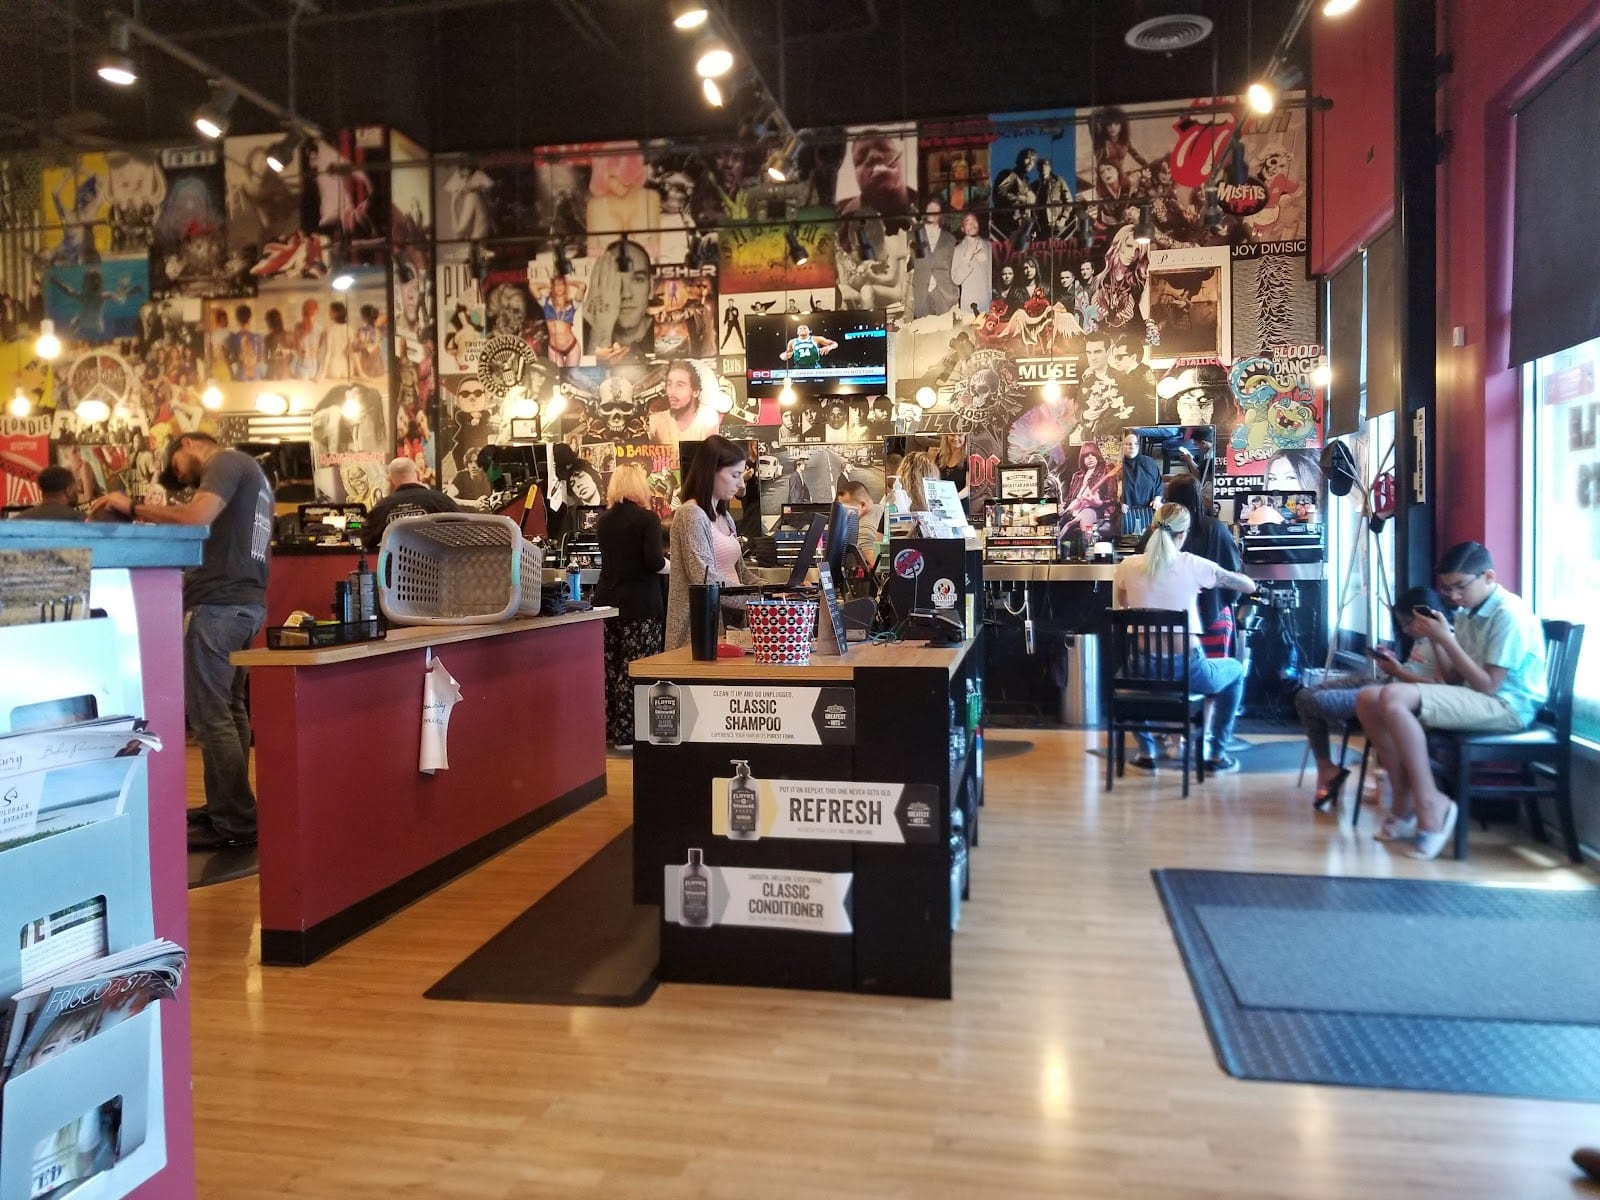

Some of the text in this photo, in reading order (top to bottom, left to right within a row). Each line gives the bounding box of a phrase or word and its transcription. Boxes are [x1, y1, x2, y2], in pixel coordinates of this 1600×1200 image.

[1218, 182, 1266, 201] MISFITS
[1232, 244, 1257, 256] JOY
[1273, 345, 1320, 359] BLOOD
[1018, 363, 1077, 380] MUSE
[1274, 358, 1319, 374] DANCE
[0, 416, 48, 435] LONDIE
[626, 444, 672, 458] BARRETT
[729, 698, 777, 714] CLASSIC
[725, 716, 781, 731] SHAMPOO
[789, 797, 882, 825] REFRESH
[762, 882, 810, 899] CLASSIC
[748, 898, 824, 918] CONDITIONER
